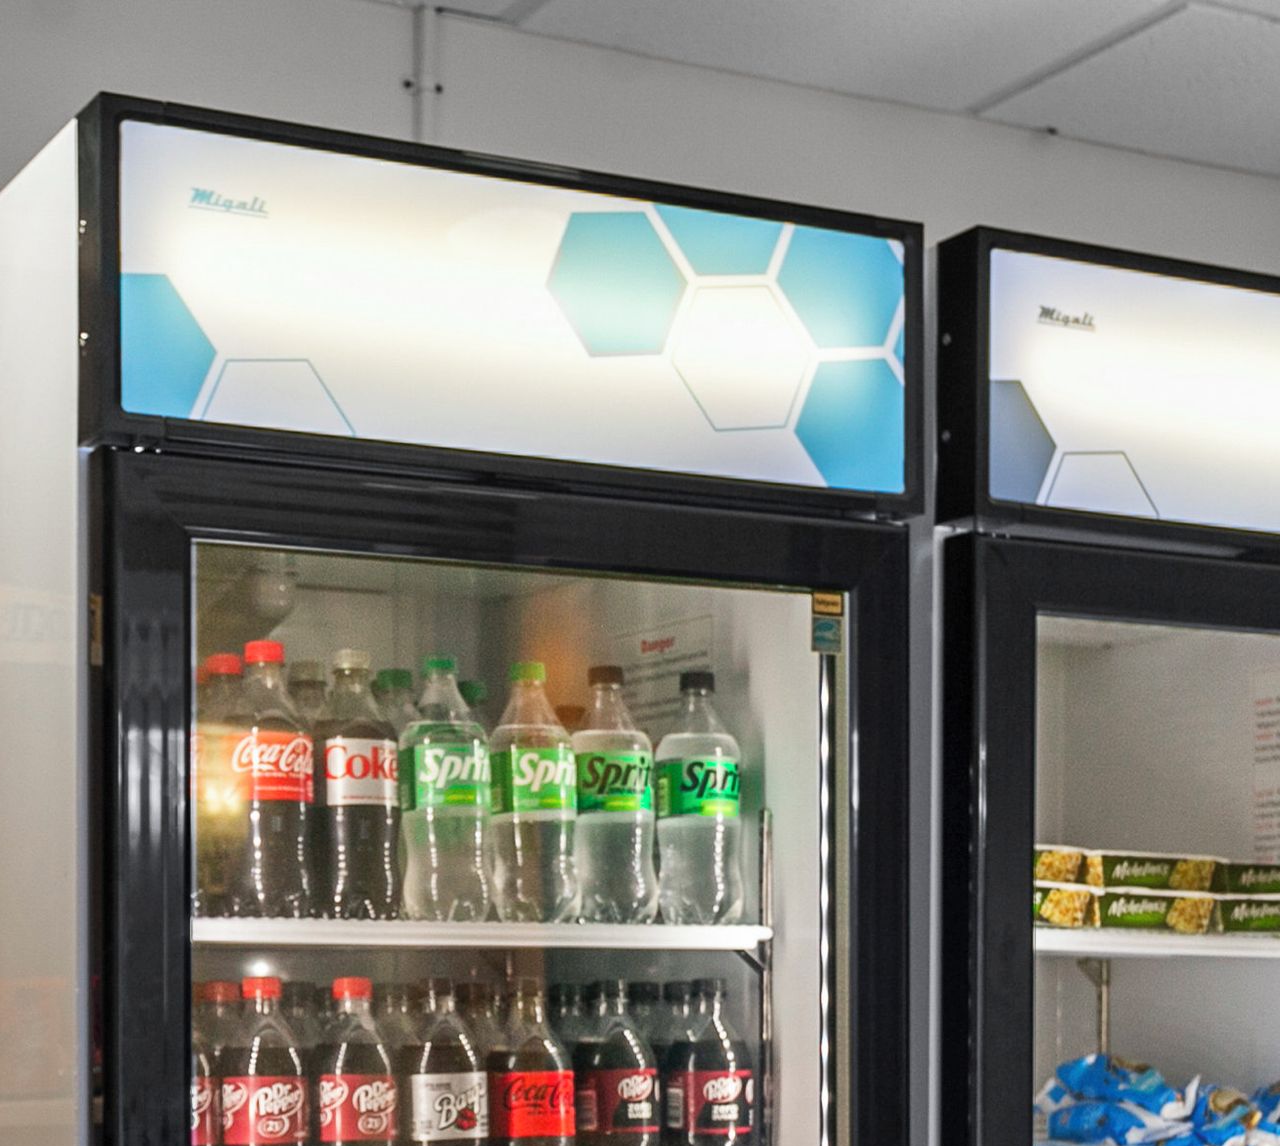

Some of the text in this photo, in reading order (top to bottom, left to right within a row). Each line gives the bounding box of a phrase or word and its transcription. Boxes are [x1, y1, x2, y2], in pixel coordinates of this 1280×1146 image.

[189, 186, 269, 217] Migali
[1038, 305, 1095, 331] Migali
[324, 744, 400, 781] Coke
